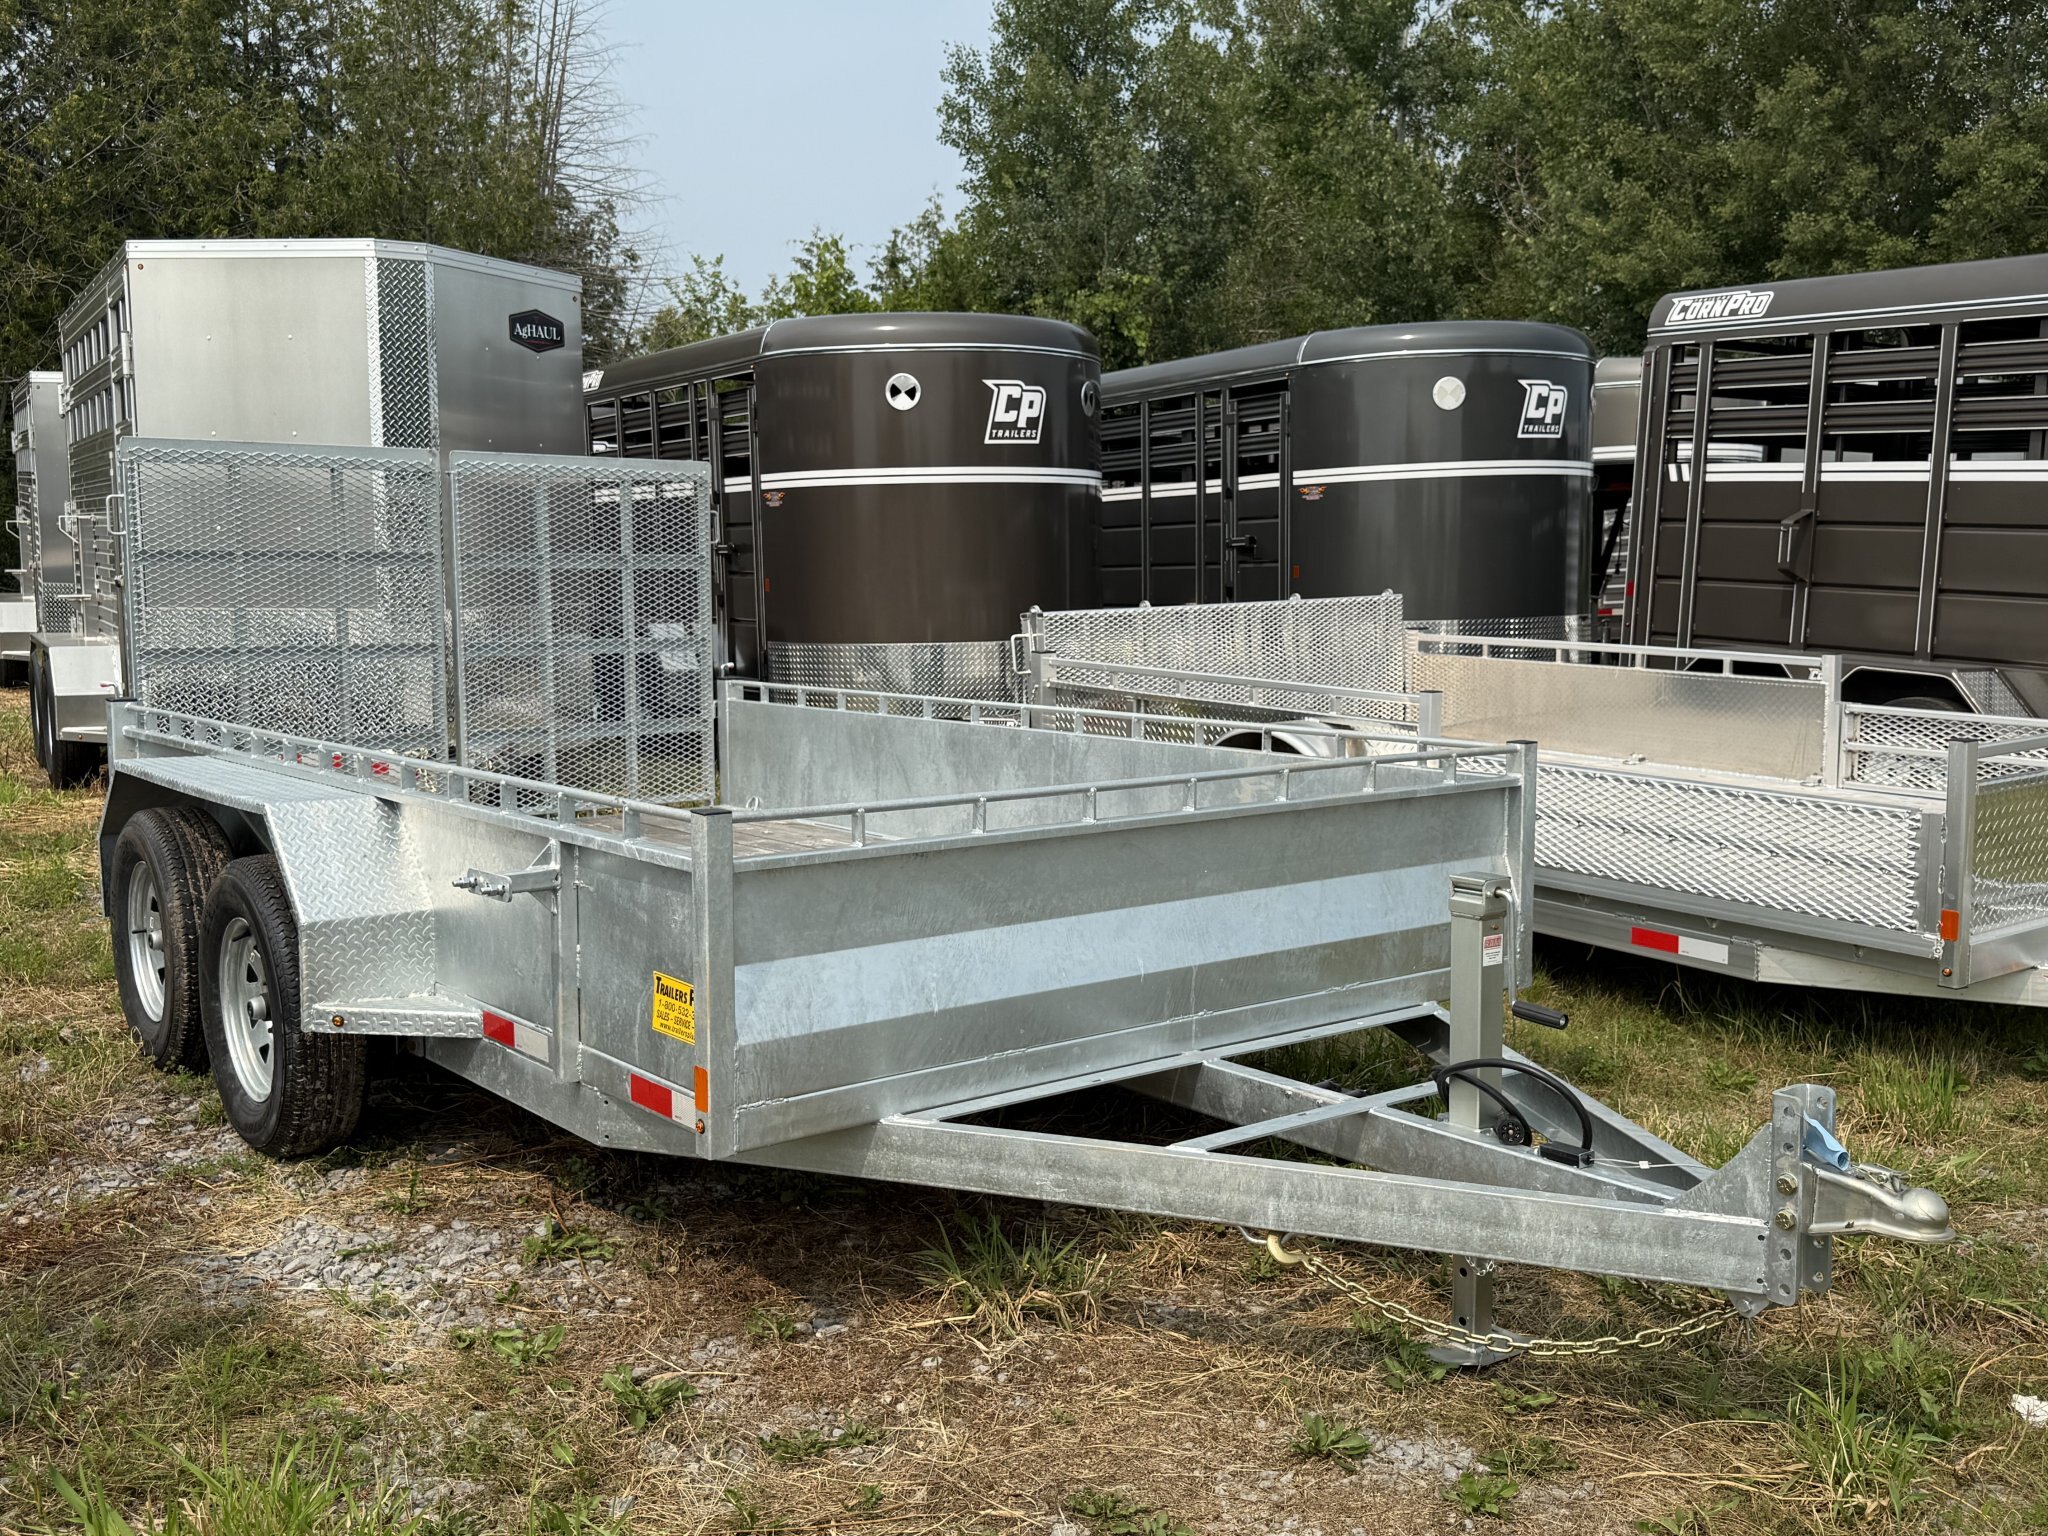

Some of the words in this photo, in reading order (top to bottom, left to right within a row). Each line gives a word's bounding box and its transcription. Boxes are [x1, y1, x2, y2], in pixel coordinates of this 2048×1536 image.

[513, 322, 561, 341] AgHAUL
[994, 386, 1042, 427] CP
[1526, 385, 1564, 423] CP
[992, 429, 1037, 438] TRAILERS
[1523, 424, 1559, 433] TRAILERS
[656, 976, 687, 1004] TRAILERS
[656, 1009, 670, 1022] SALES
[674, 1015, 691, 1030] SERVICE
